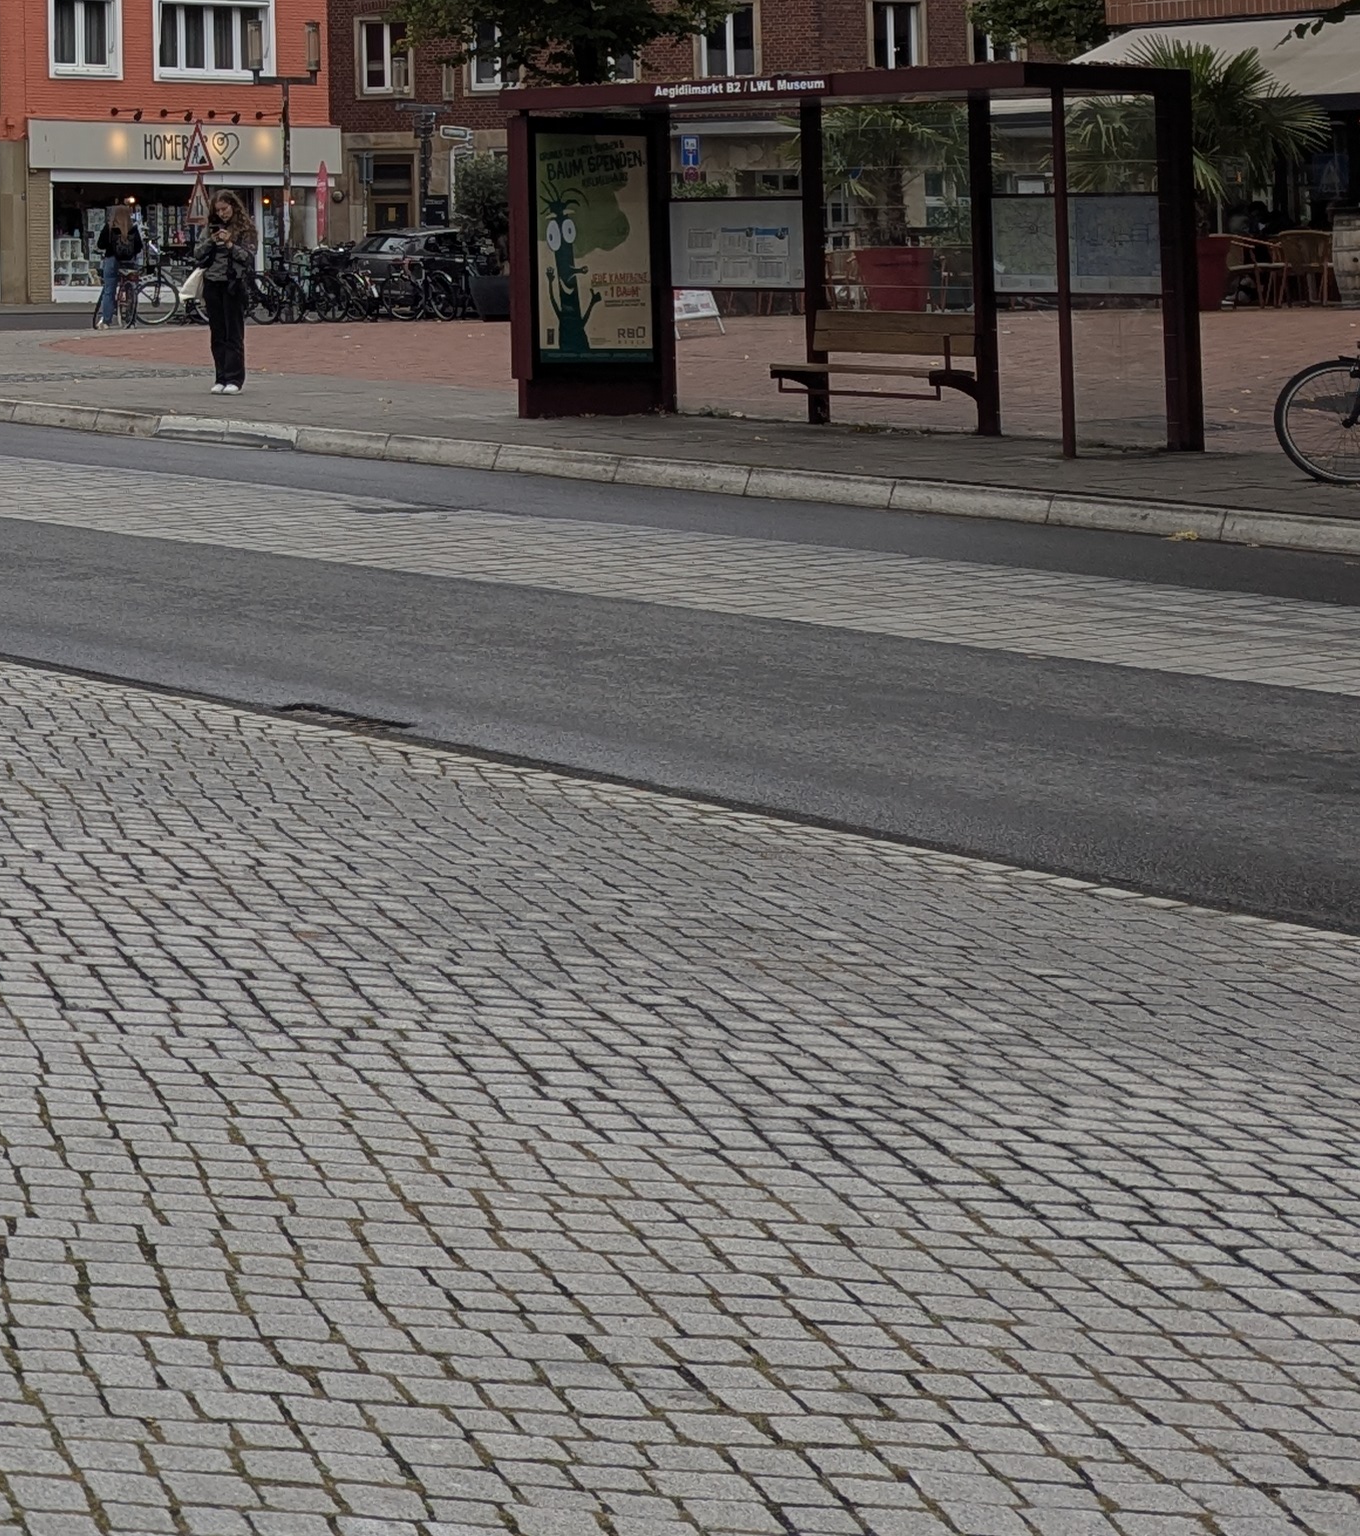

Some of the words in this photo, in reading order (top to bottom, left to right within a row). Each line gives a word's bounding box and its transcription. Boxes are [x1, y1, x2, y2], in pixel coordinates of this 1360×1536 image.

[654, 83, 724, 99] Aegidiimarkt
[726, 81, 741, 94] B2
[750, 80, 775, 93] LWL
[777, 78, 826, 92] Museum
